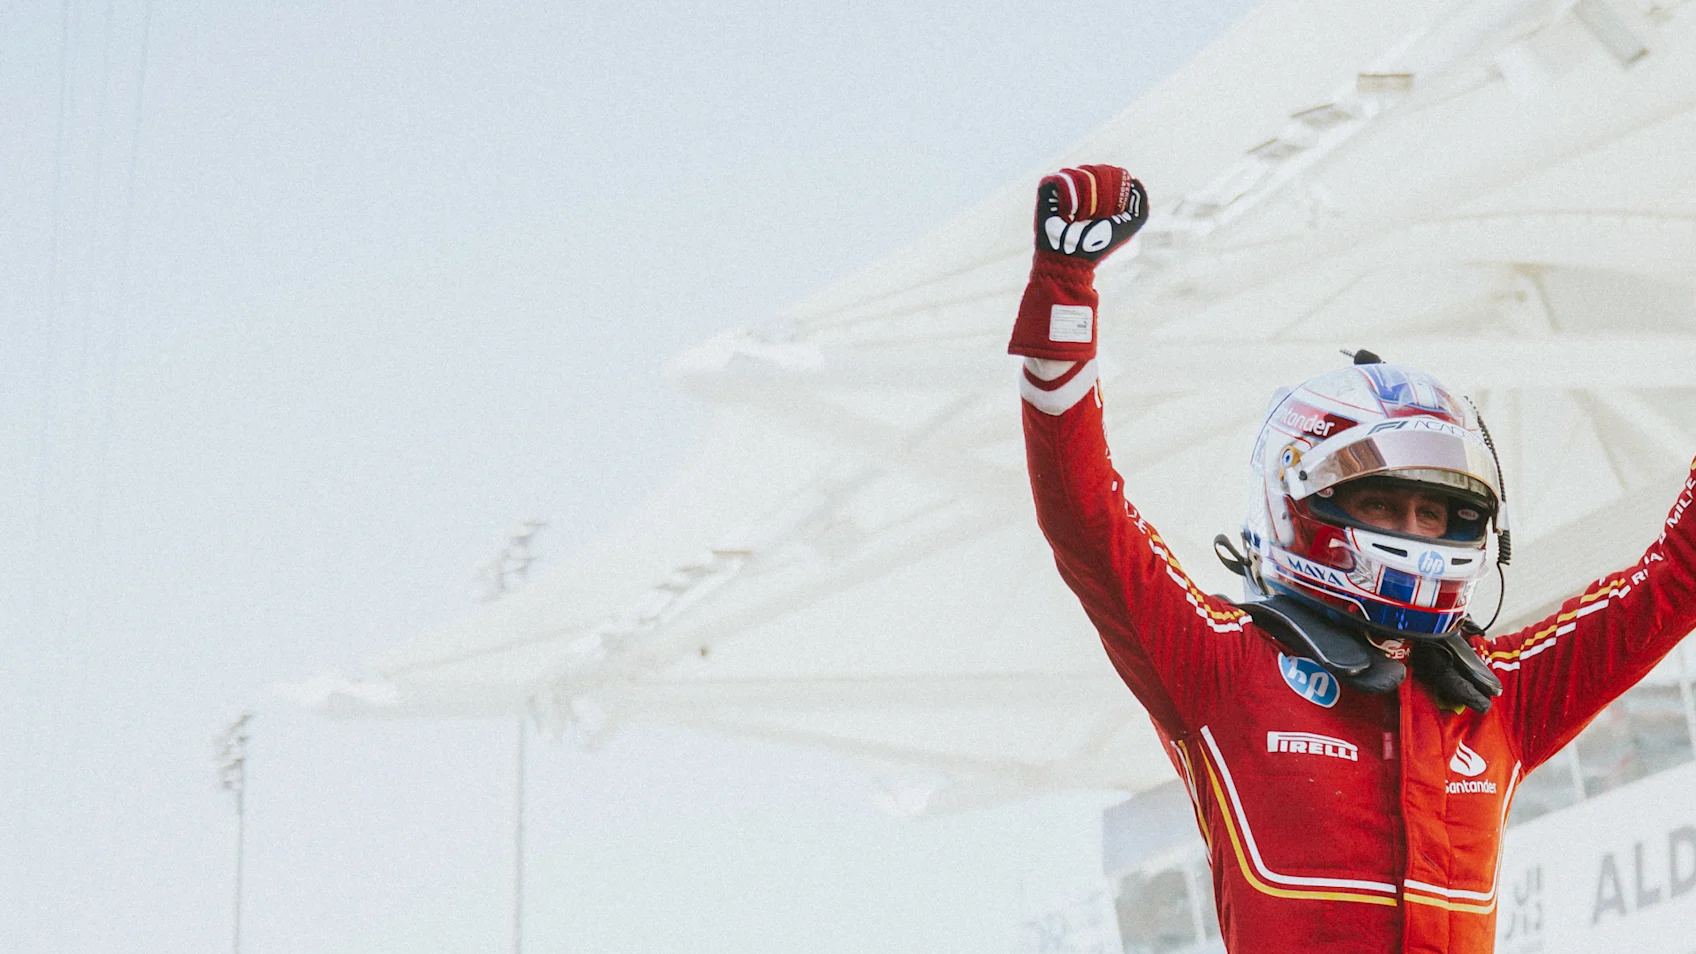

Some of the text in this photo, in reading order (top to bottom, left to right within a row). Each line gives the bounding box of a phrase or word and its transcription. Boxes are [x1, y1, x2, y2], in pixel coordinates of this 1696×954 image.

[1287, 556, 1343, 586] MAYA
[1420, 551, 1443, 578] hp
[1286, 656, 1330, 701] hp
[1267, 731, 1358, 761] PIRELLI
